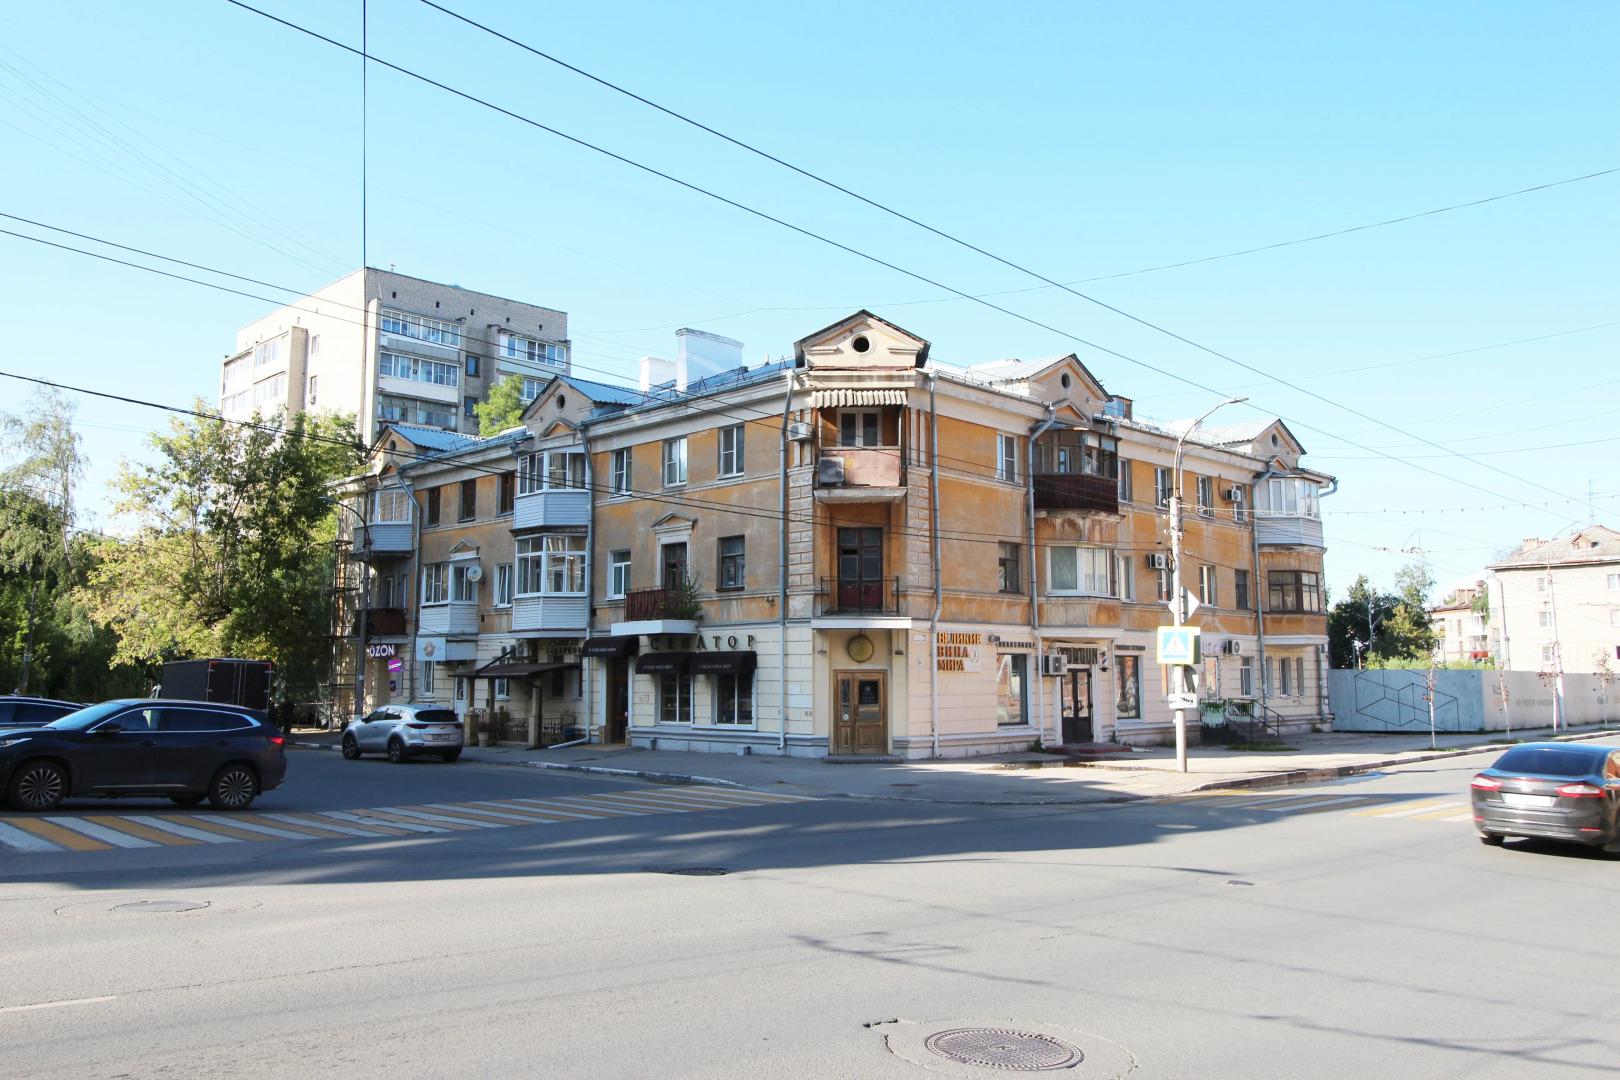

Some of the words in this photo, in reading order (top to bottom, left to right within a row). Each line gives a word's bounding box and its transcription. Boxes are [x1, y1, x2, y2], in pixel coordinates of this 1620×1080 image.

[650, 633, 756, 651] СЕНАТОР
[937, 632, 981, 644] ВЕЛИКИЕ
[369, 645, 395, 657] OZON
[937, 645, 970, 658] ВИНА
[937, 659, 965, 671] МИРА
